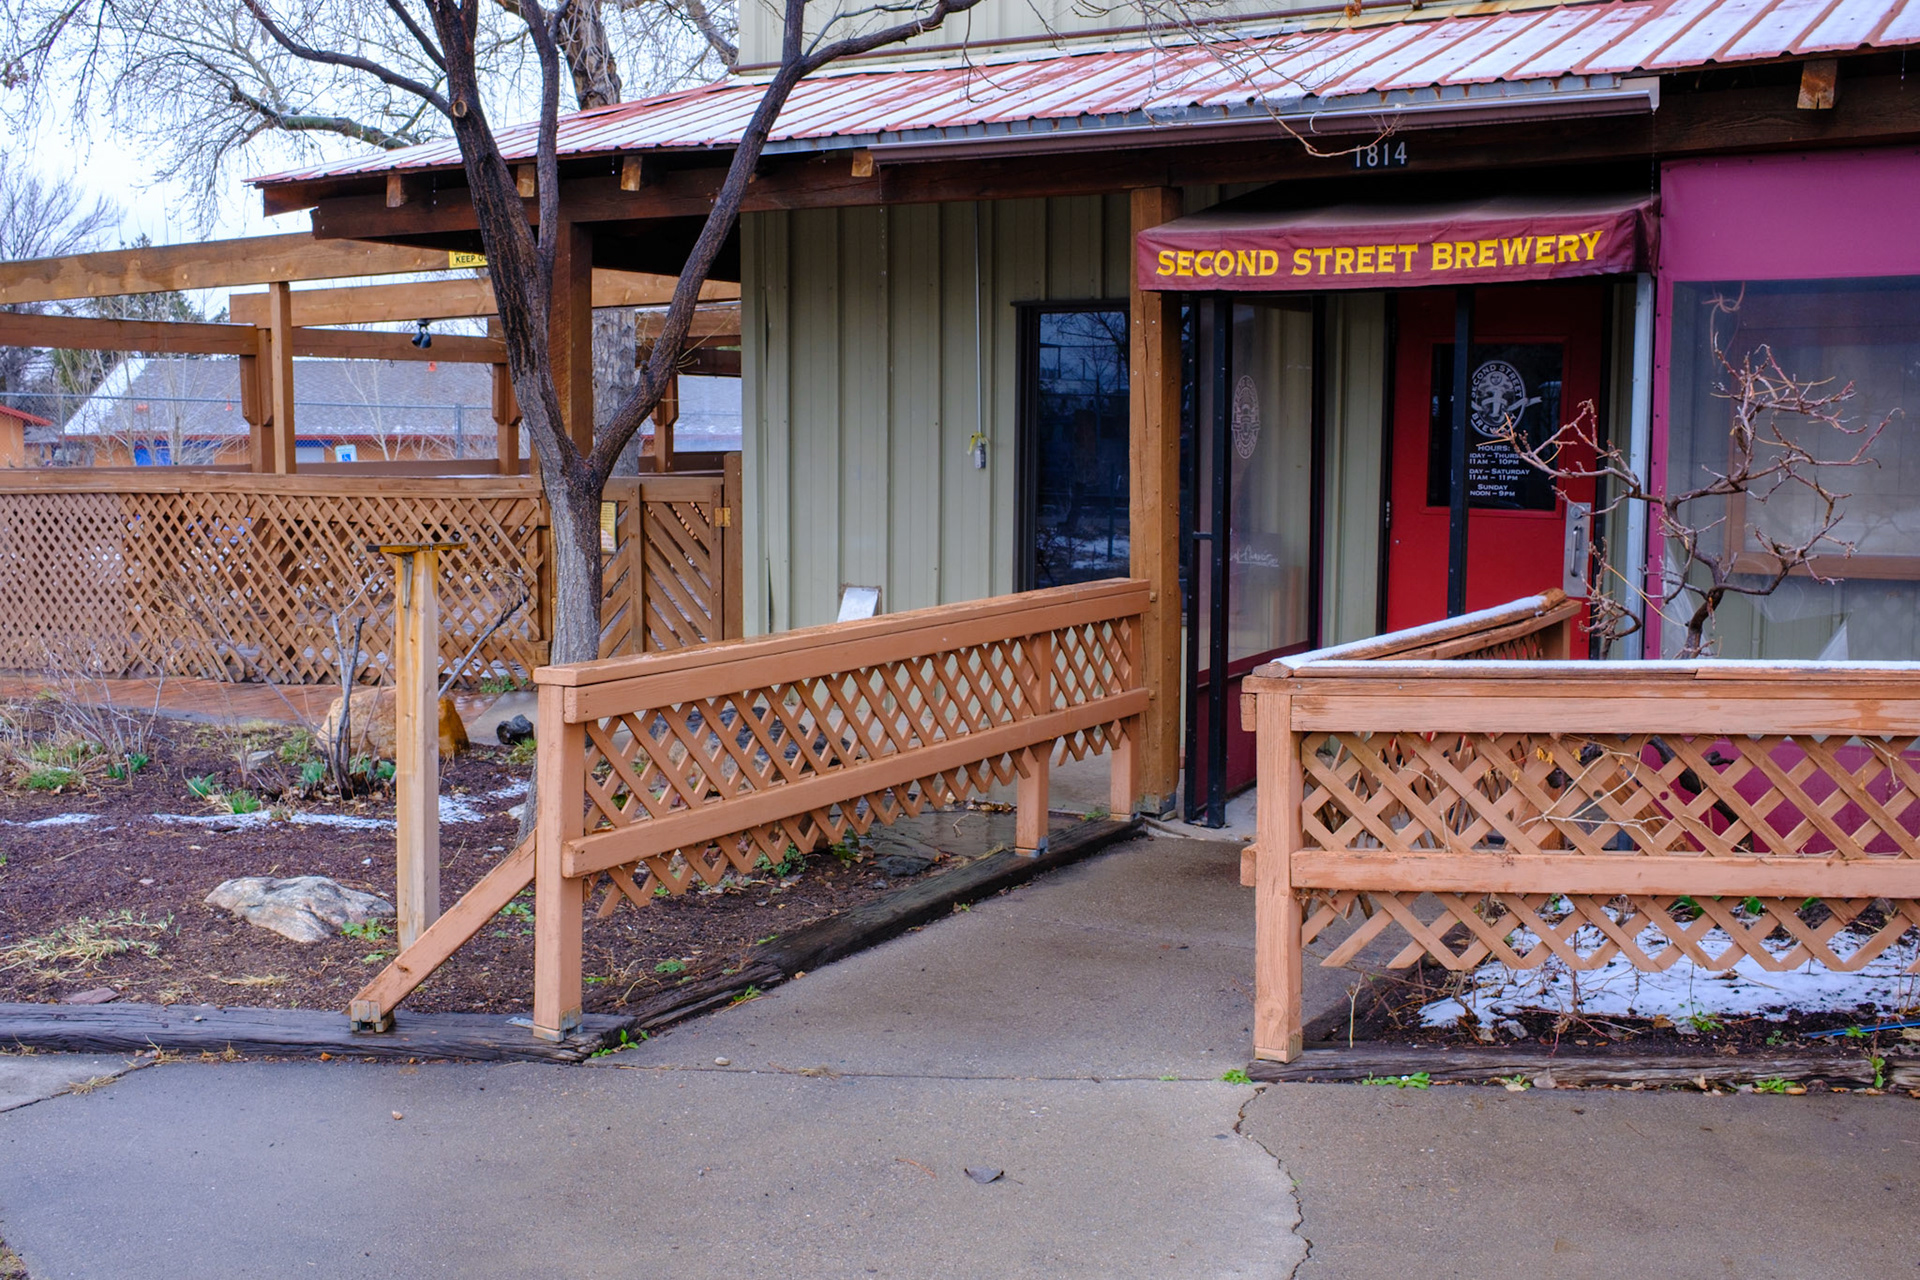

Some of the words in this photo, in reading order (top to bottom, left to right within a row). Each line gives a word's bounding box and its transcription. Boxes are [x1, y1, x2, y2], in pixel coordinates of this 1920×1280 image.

[1355, 141, 1408, 168] 1814
[456, 255, 475, 263] KEEP
[1155, 249, 1279, 277] SECOND
[1291, 244, 1419, 276] STREET
[1430, 230, 1604, 271] BREWERY
[1499, 365, 1523, 398] STREET
[1491, 467, 1530, 475] SATURDAY
[1477, 483, 1508, 491] SUNDAY
